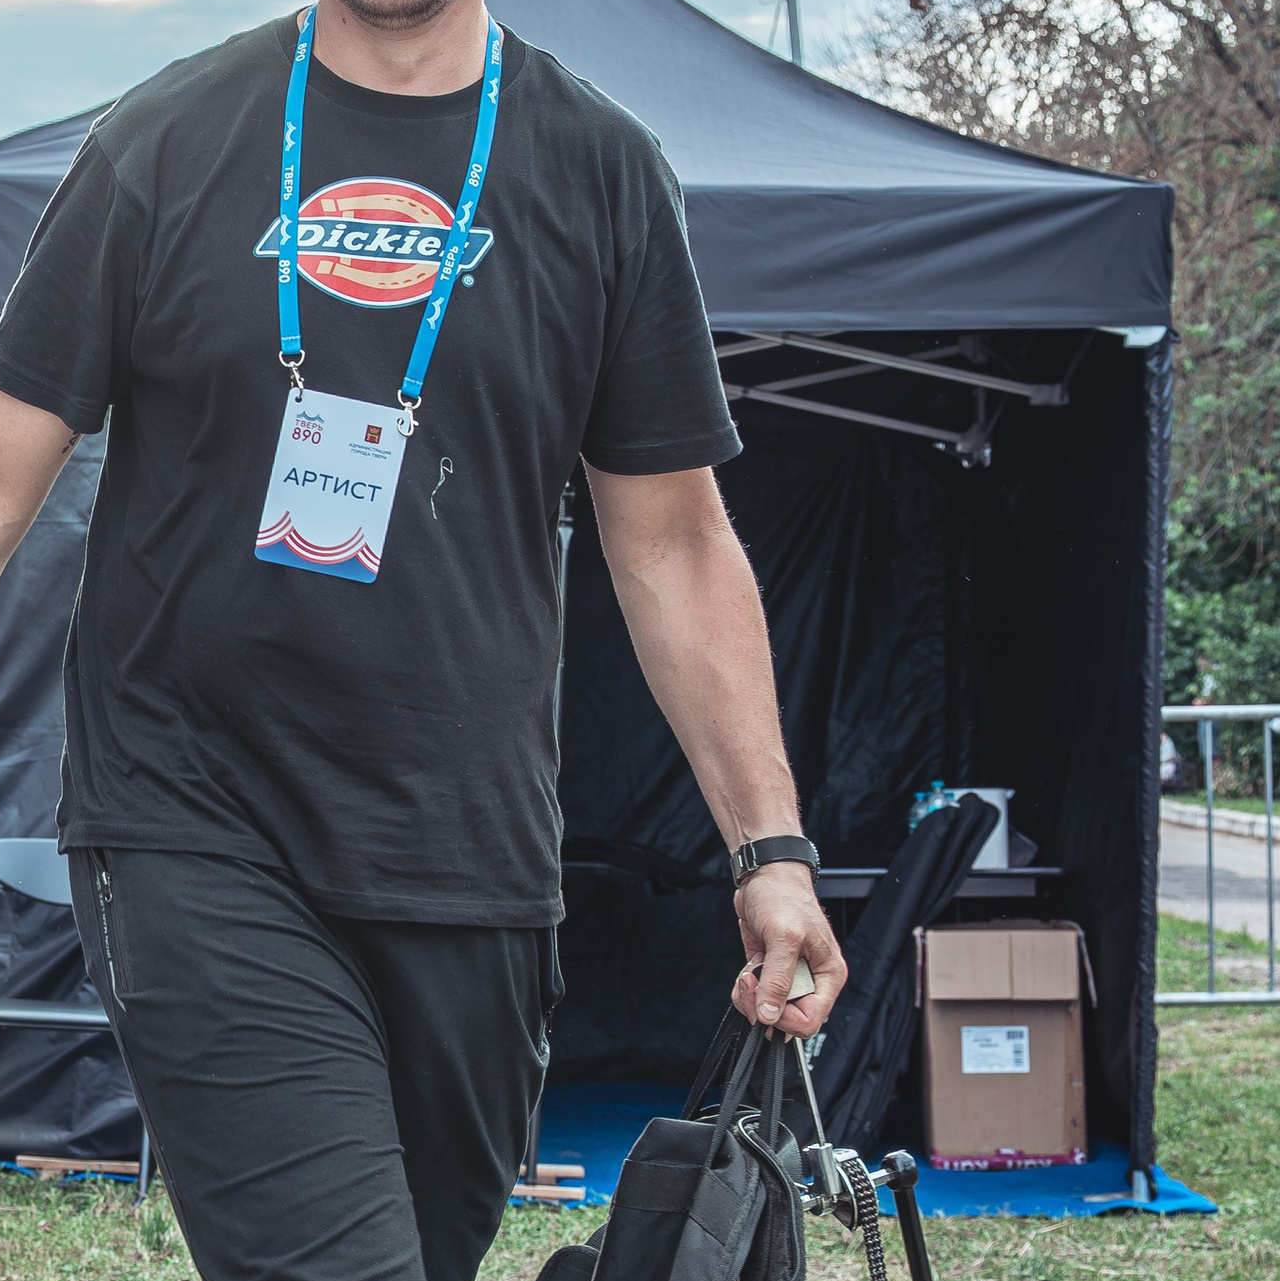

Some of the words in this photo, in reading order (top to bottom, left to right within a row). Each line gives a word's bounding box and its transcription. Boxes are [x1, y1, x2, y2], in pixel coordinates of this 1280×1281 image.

[295, 42, 308, 62] 890
[440, 245, 459, 281] ТВЕРЬ
[468, 163, 483, 187] 890
[491, 39, 500, 65] ТВЕРЬ
[283, 164, 295, 201] ТВЕРЬ
[297, 223, 470, 257] Dickie
[278, 259, 291, 283] 890
[291, 427, 322, 445] 890
[295, 419, 324, 432] ТВЕРЬ
[283, 467, 383, 502] АРТИСТ
